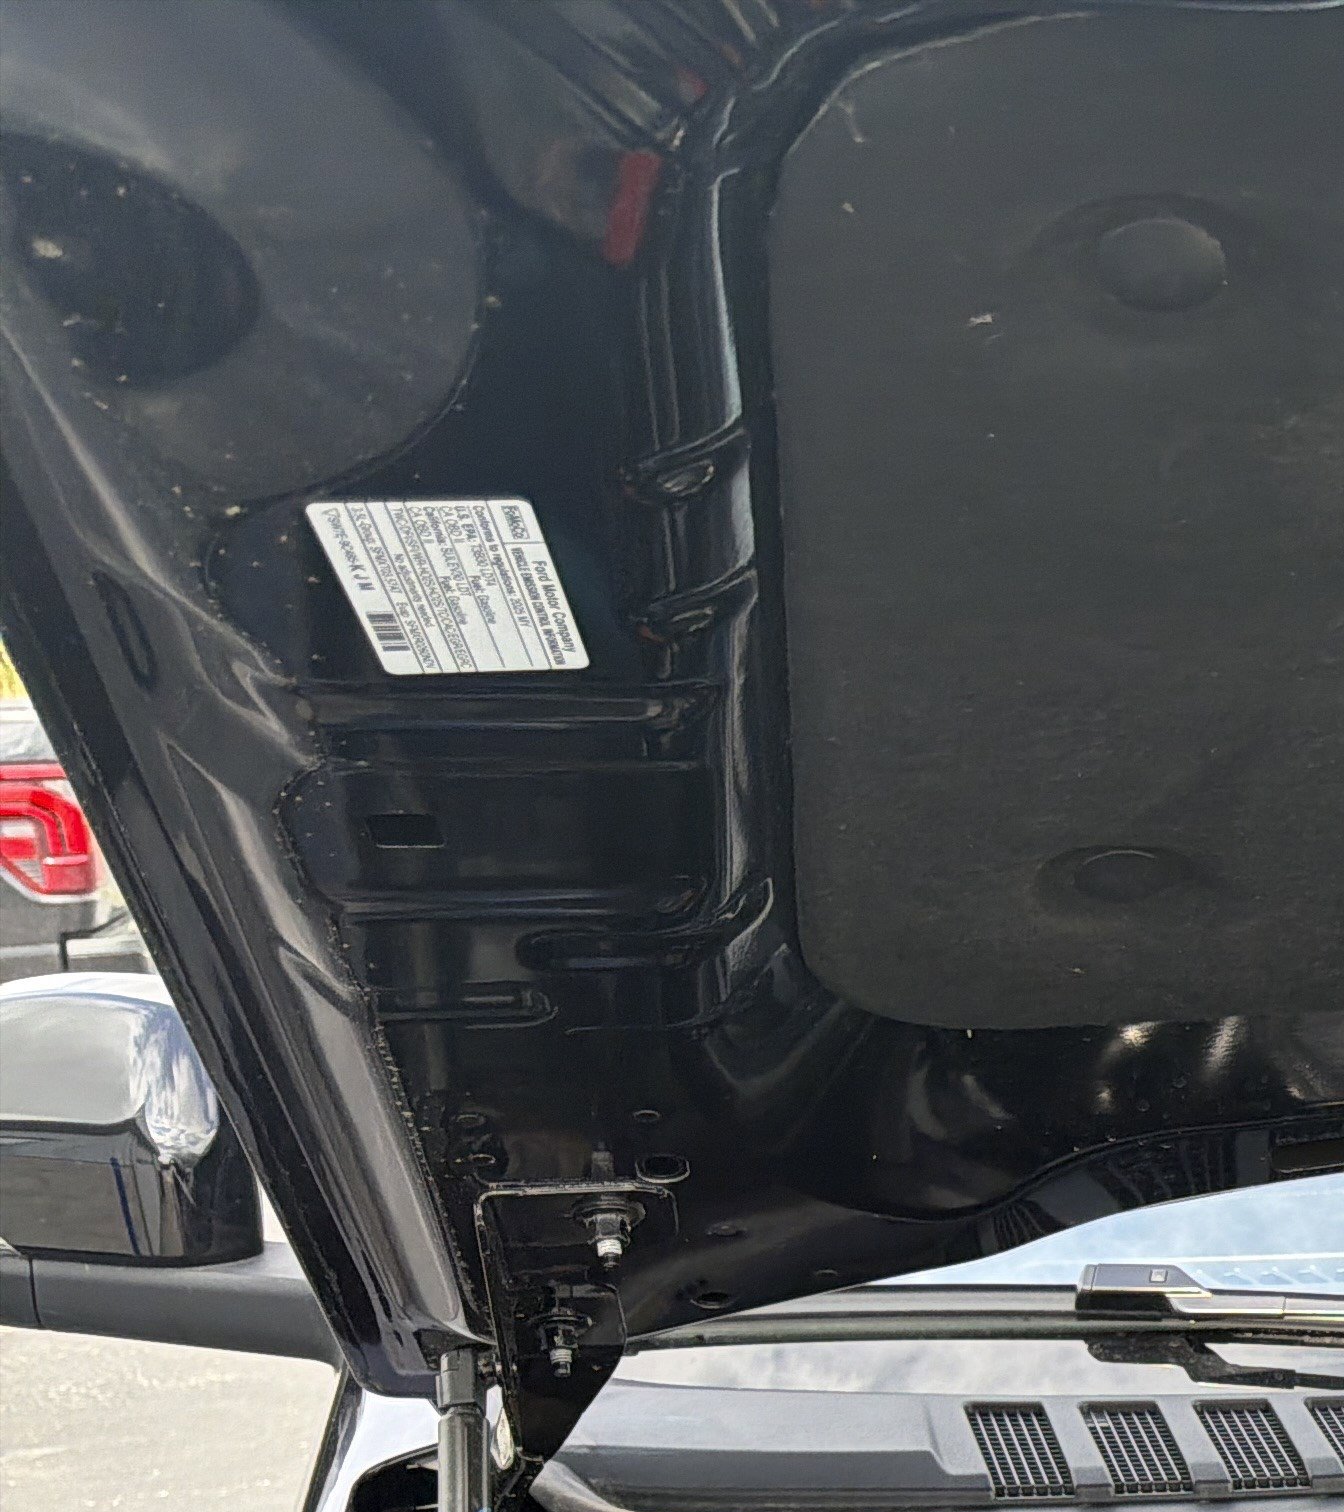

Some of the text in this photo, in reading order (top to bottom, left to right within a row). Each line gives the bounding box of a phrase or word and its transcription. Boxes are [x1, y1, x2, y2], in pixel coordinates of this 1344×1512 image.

[488, 544, 500, 552] to
[531, 560, 578, 653] Ford Motor Company
